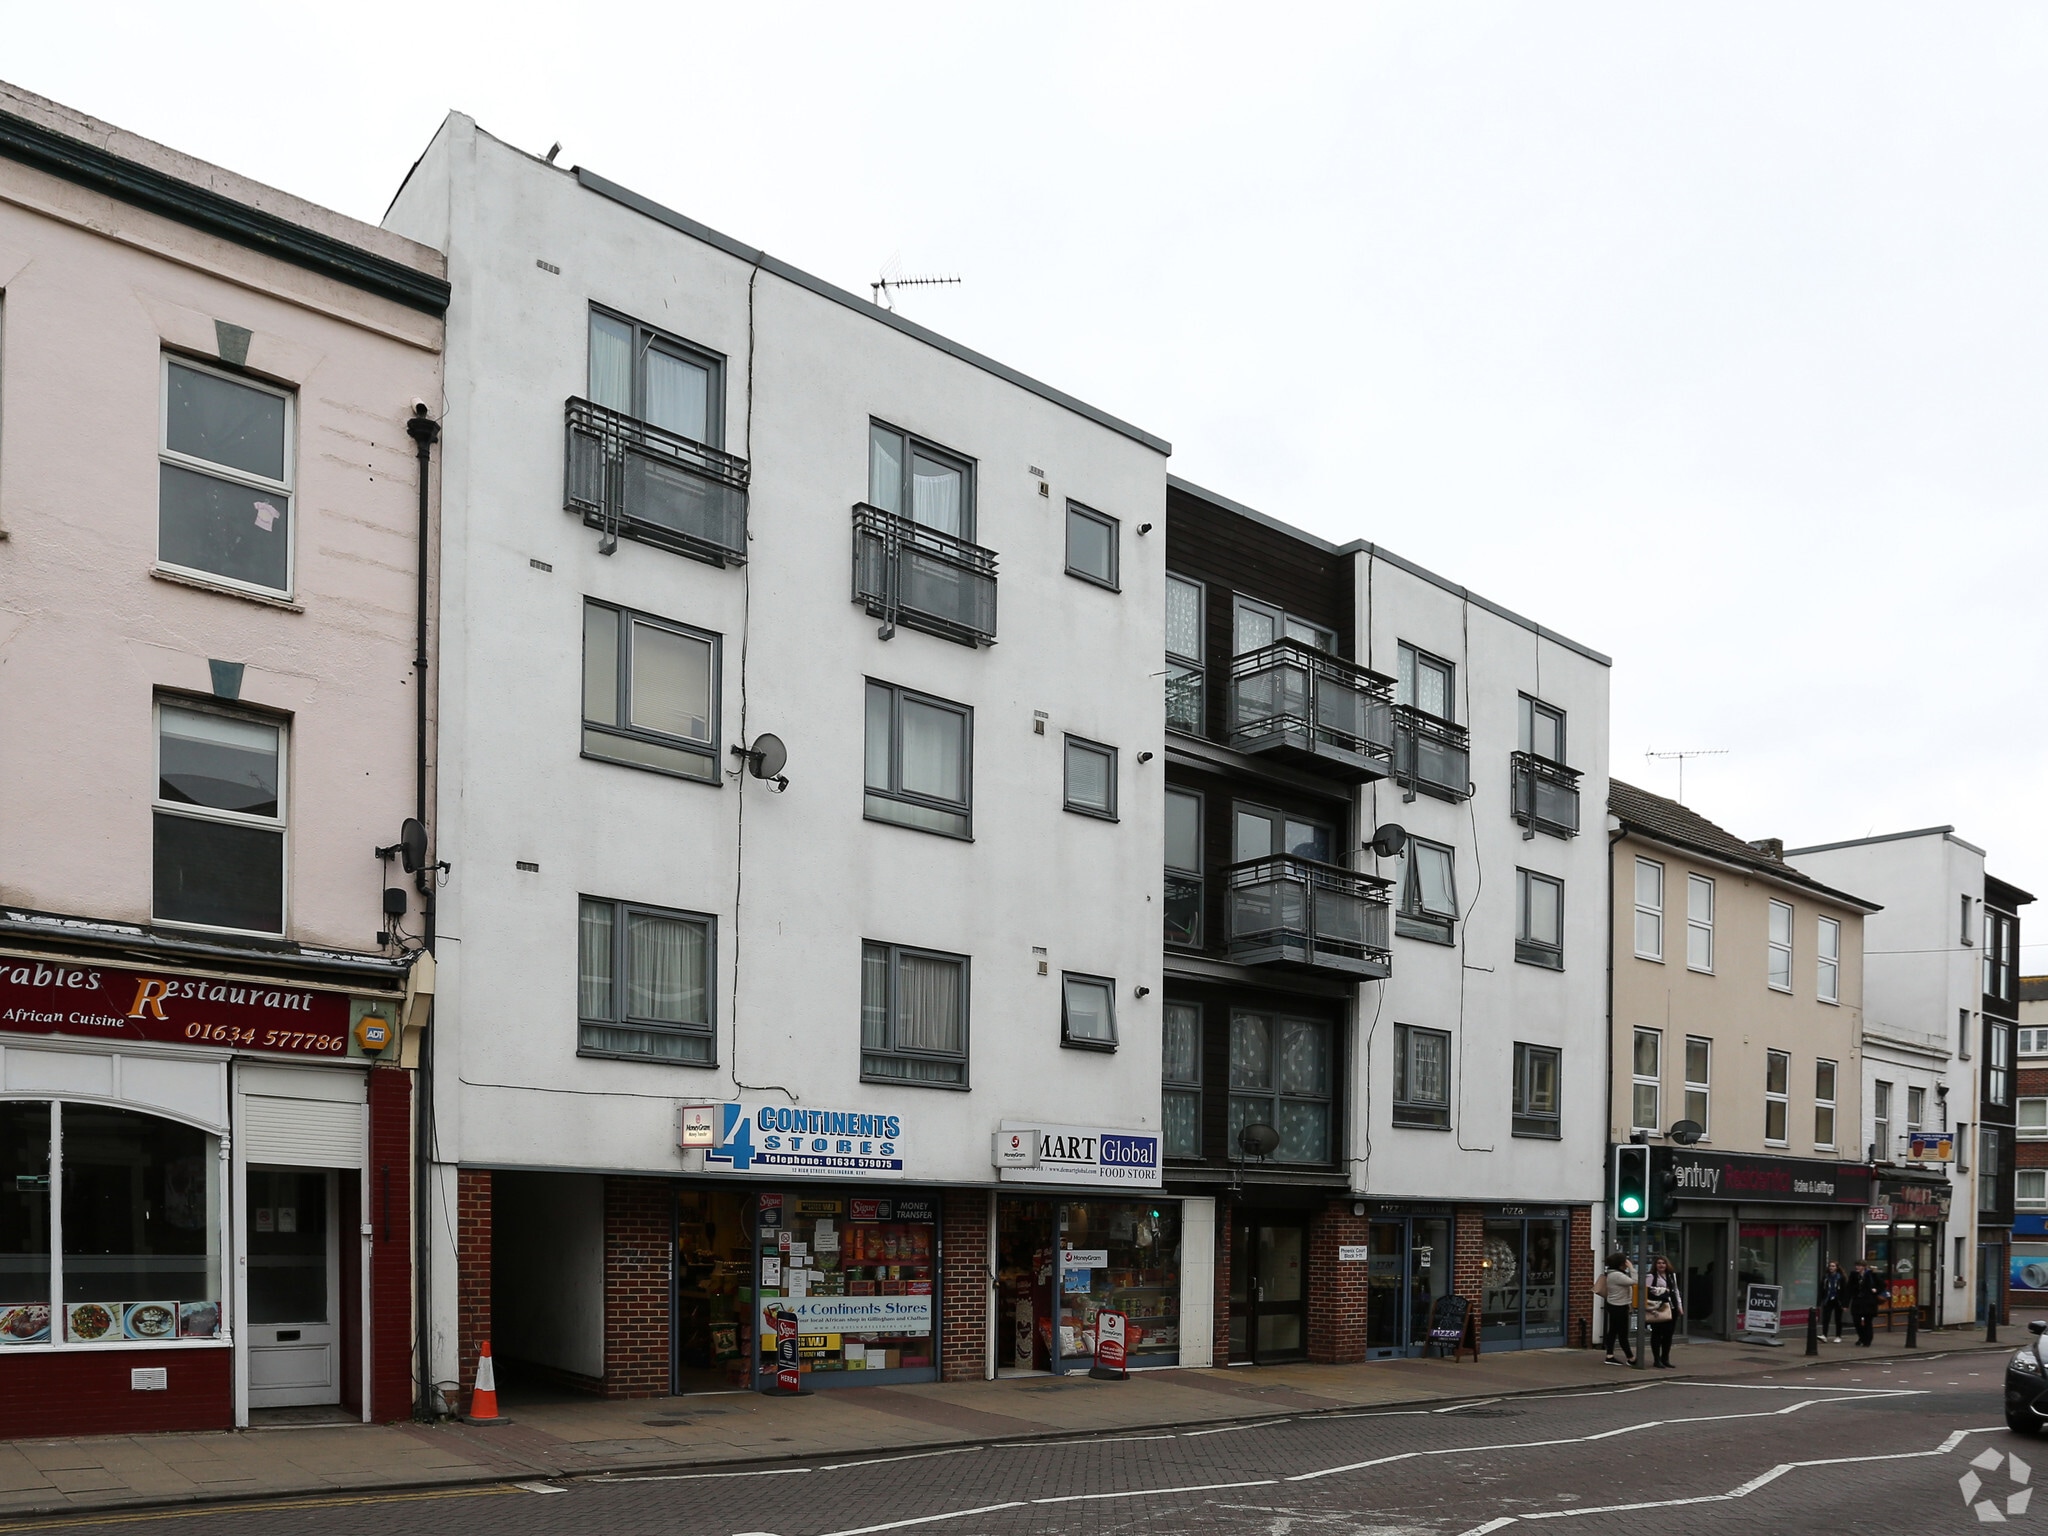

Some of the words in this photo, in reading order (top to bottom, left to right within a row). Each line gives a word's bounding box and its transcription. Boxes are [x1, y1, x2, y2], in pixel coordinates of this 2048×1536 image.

[126, 977, 314, 1021] Restaurant
[2, 1008, 63, 1022] African
[69, 1012, 125, 1027] Cuisine
[185, 1021, 256, 1044] 01634
[263, 1030, 344, 1051] 577786
[367, 1028, 385, 1040] ADT
[711, 1103, 756, 1170] 4
[758, 1106, 901, 1139] CONTINENTS
[764, 1135, 901, 1156] STORES
[1102, 1139, 1154, 1164] Global
[765, 1154, 823, 1165] Telephone:
[826, 1157, 855, 1168] 01634
[858, 1159, 892, 1169] 579075
[1100, 1167, 1126, 1178] FOOD
[1128, 1169, 1157, 1179] STORE
[1672, 1162, 1720, 1194] entury
[1724, 1164, 1791, 1192] Residential
[1793, 1179, 1808, 1192] Sales
[1814, 1181, 1835, 1195] Lettings
[760, 1195, 782, 1206] Sigue
[853, 1201, 876, 1214] Sigue
[900, 1202, 929, 1210] MONEY
[896, 1211, 933, 1219] TRANSFER
[1073, 1254, 1101, 1262] MoneyGram
[797, 1304, 808, 1315] 4
[811, 1303, 881, 1316] Continents
[885, 1302, 928, 1314] Stores
[1750, 1298, 1777, 1308] OPEN
[847, 1316, 860, 1324] shop
[867, 1315, 895, 1323] Gillingham
[779, 1321, 796, 1337] Sigue
[1433, 1327, 1460, 1337] rizzar
[780, 1374, 793, 1383] HERE
